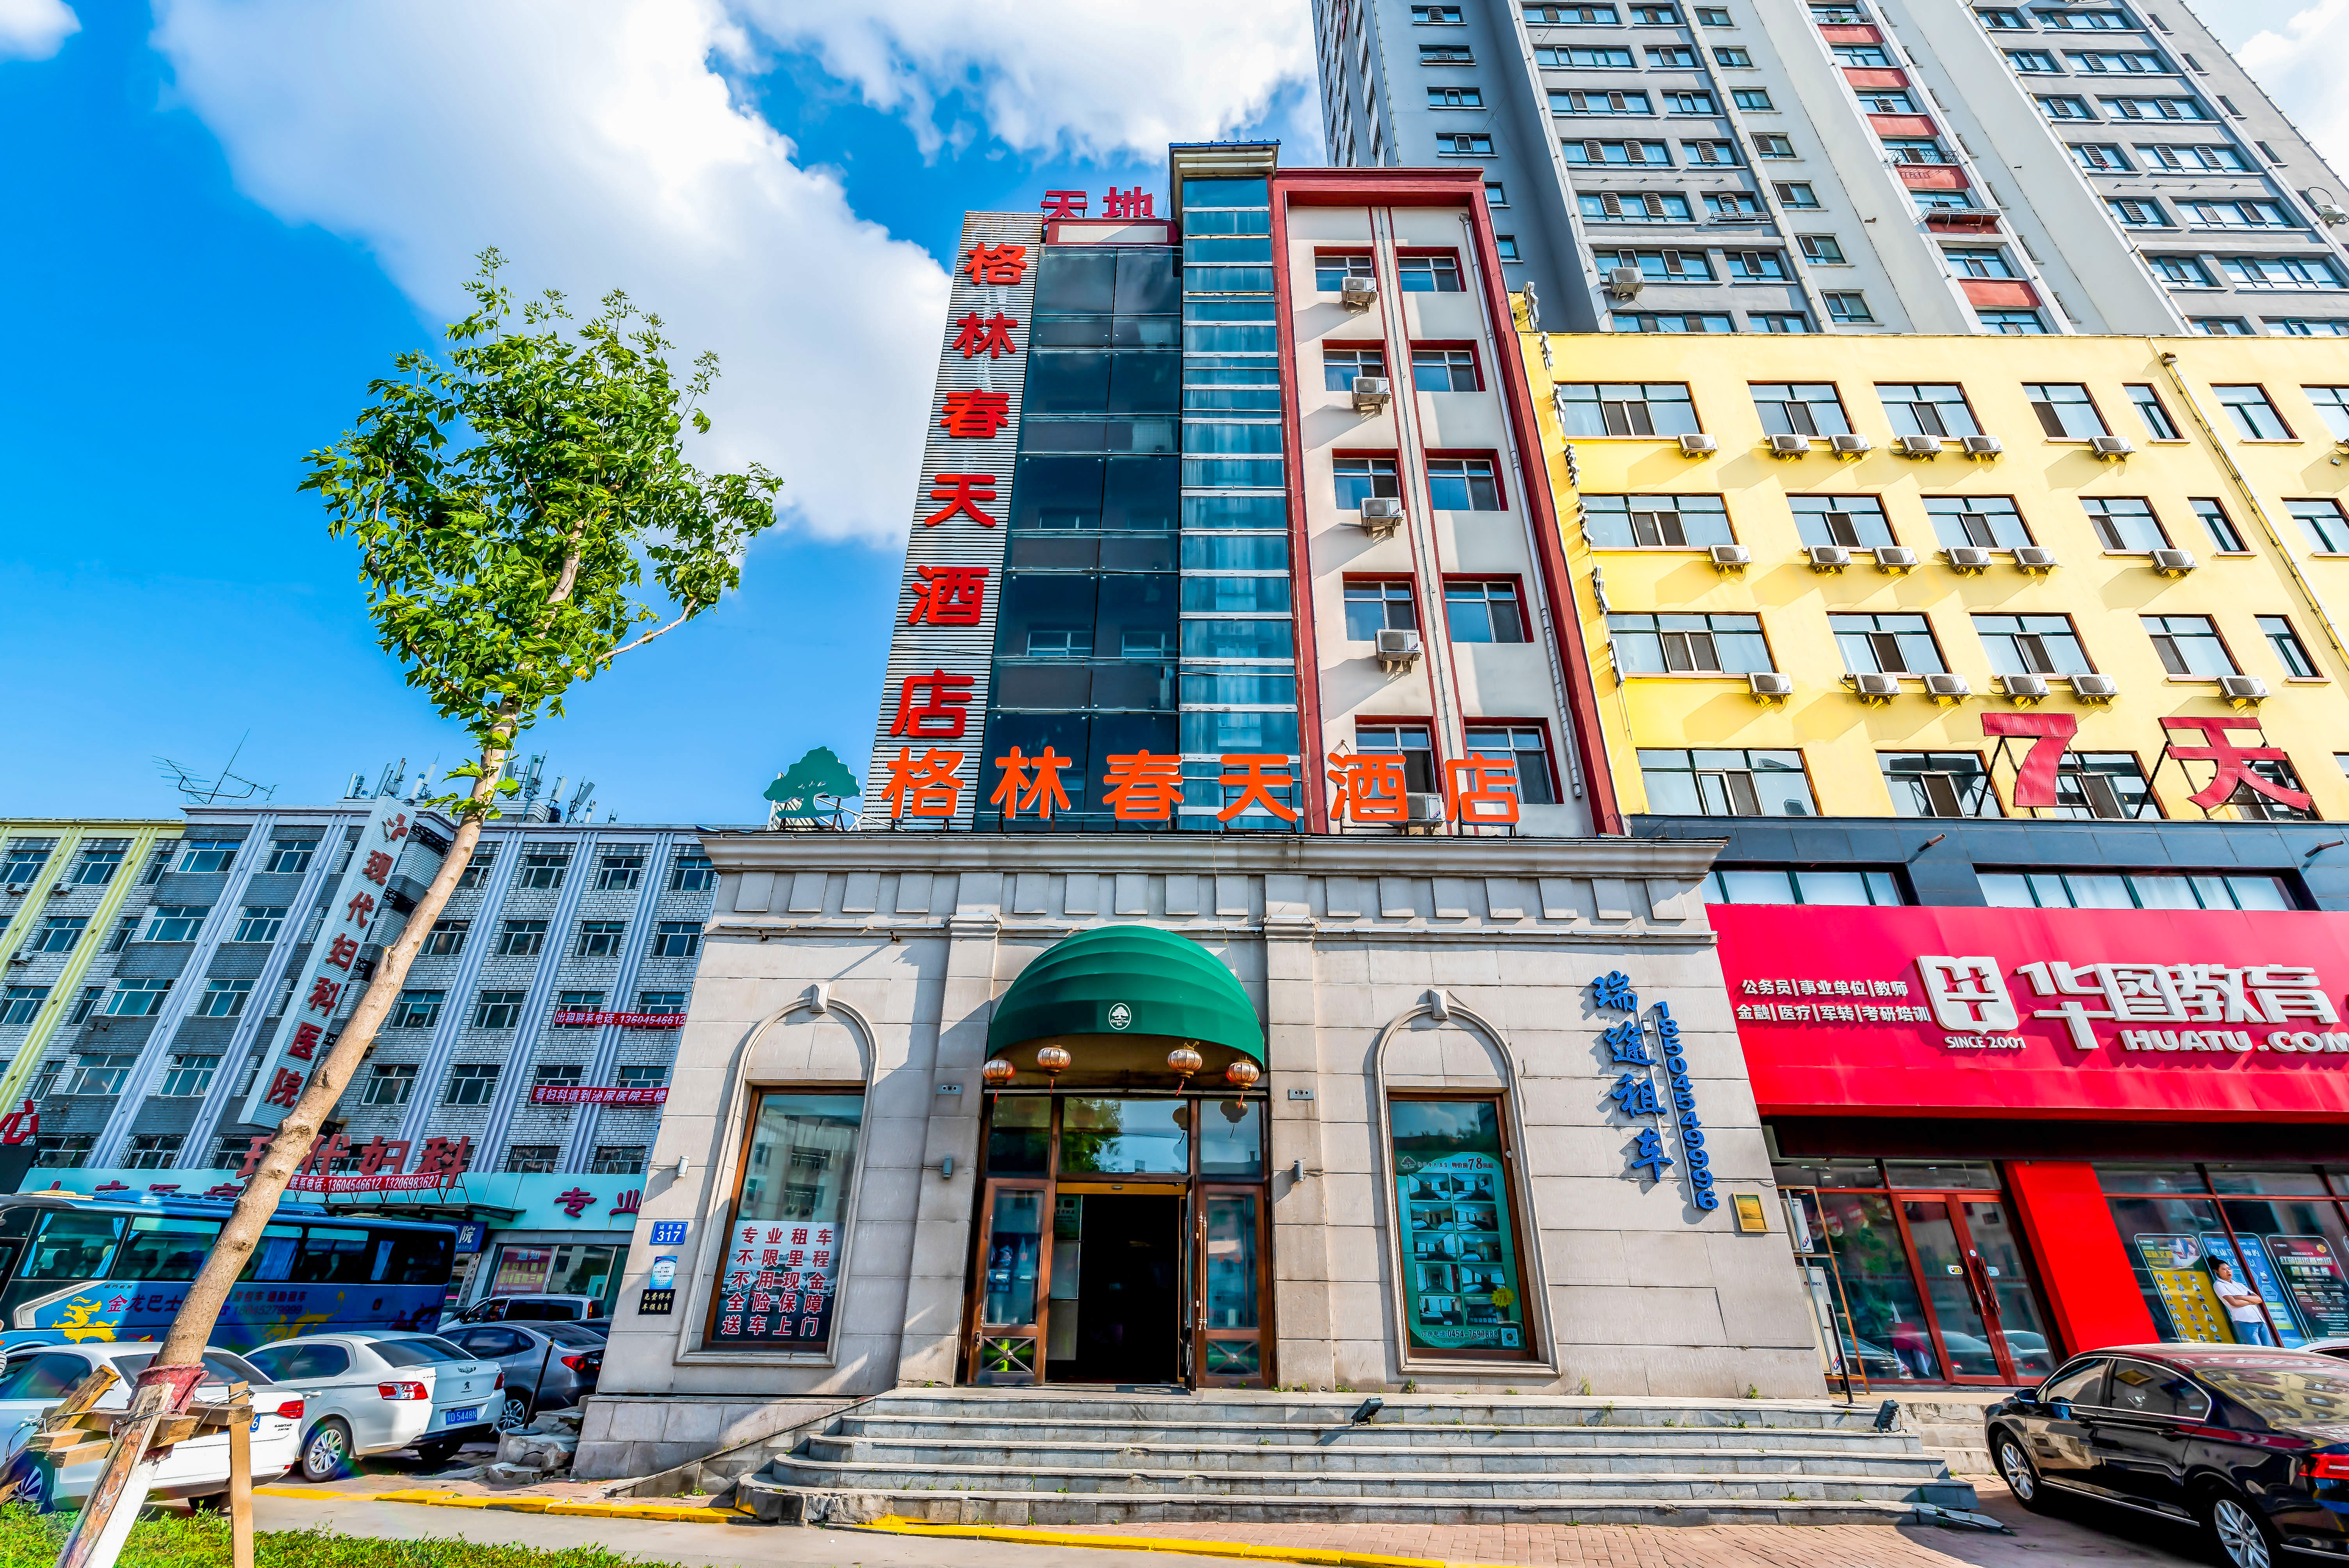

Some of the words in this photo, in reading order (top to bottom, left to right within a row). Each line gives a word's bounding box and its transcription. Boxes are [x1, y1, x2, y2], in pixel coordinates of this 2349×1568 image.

[1040, 186, 1156, 224] 天地
[889, 242, 1028, 739] 格林春天酒店
[1980, 713, 2313, 811] 7天
[880, 746, 1520, 826] 格林春天酒店
[264, 849, 394, 1108] 现代妇科医院
[2017, 960, 2341, 1049] 华图教育
[1945, 1036, 1986, 1049] SINCE
[1989, 1035, 2026, 1049] 2001
[2119, 1029, 2349, 1053] HUATU.COM
[1592, 970, 1674, 1183] 瑞途租车
[535, 1087, 667, 1103] 看妇科请到泌尿医院三楼
[1654, 1001, 1719, 1210] 18504549996
[385, 1174, 440, 1189] 13206983627
[554, 1186, 644, 1218] 专业
[656, 1230, 681, 1242] 317
[741, 1226, 834, 1246] 专业租车
[736, 1249, 830, 1269] 不限里程
[731, 1270, 827, 1290] 不用现金
[107, 1294, 184, 1313] 金龙巴士
[726, 1292, 823, 1314] 全险保障
[721, 1315, 819, 1336] 送车上门
[456, 1410, 477, 1422] 5448N
